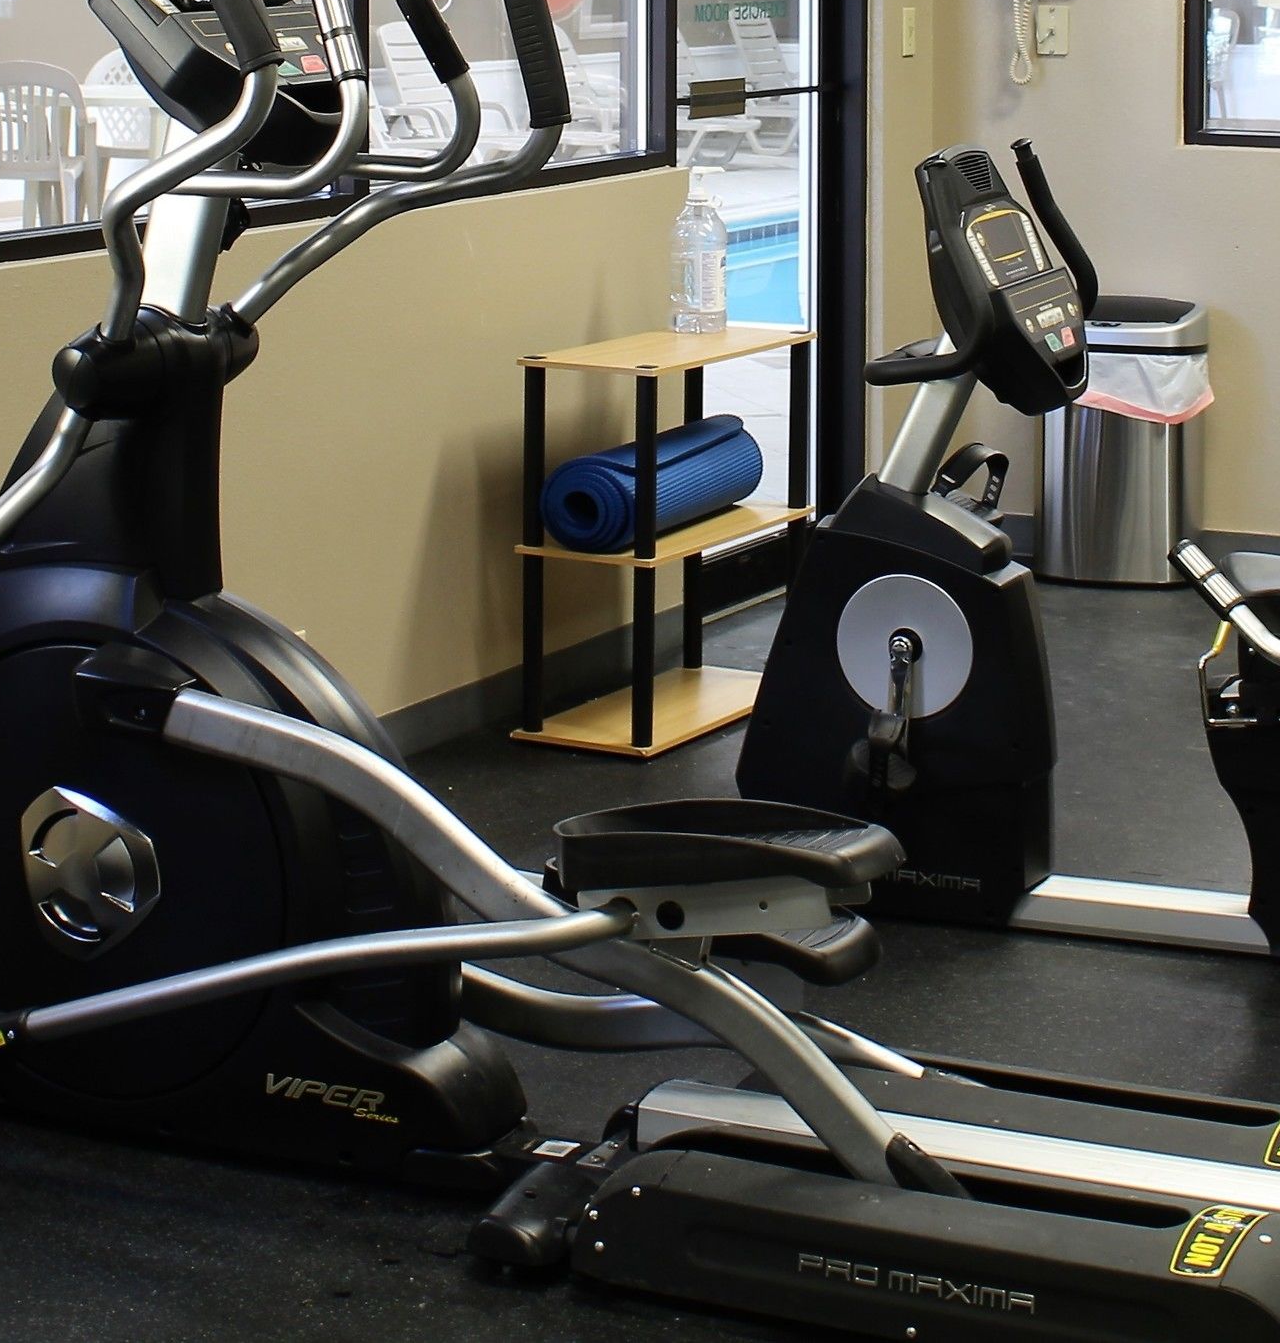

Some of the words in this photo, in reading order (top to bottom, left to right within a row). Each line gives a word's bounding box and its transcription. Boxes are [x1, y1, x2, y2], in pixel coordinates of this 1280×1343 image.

[265, 1072, 385, 1112] VIPER
[353, 1107, 400, 1124] Series
[1203, 1222, 1234, 1234] A
[1183, 1232, 1225, 1268] NOT
[798, 1253, 878, 1287] PRO
[888, 1269, 1035, 1315] MAXIMA
